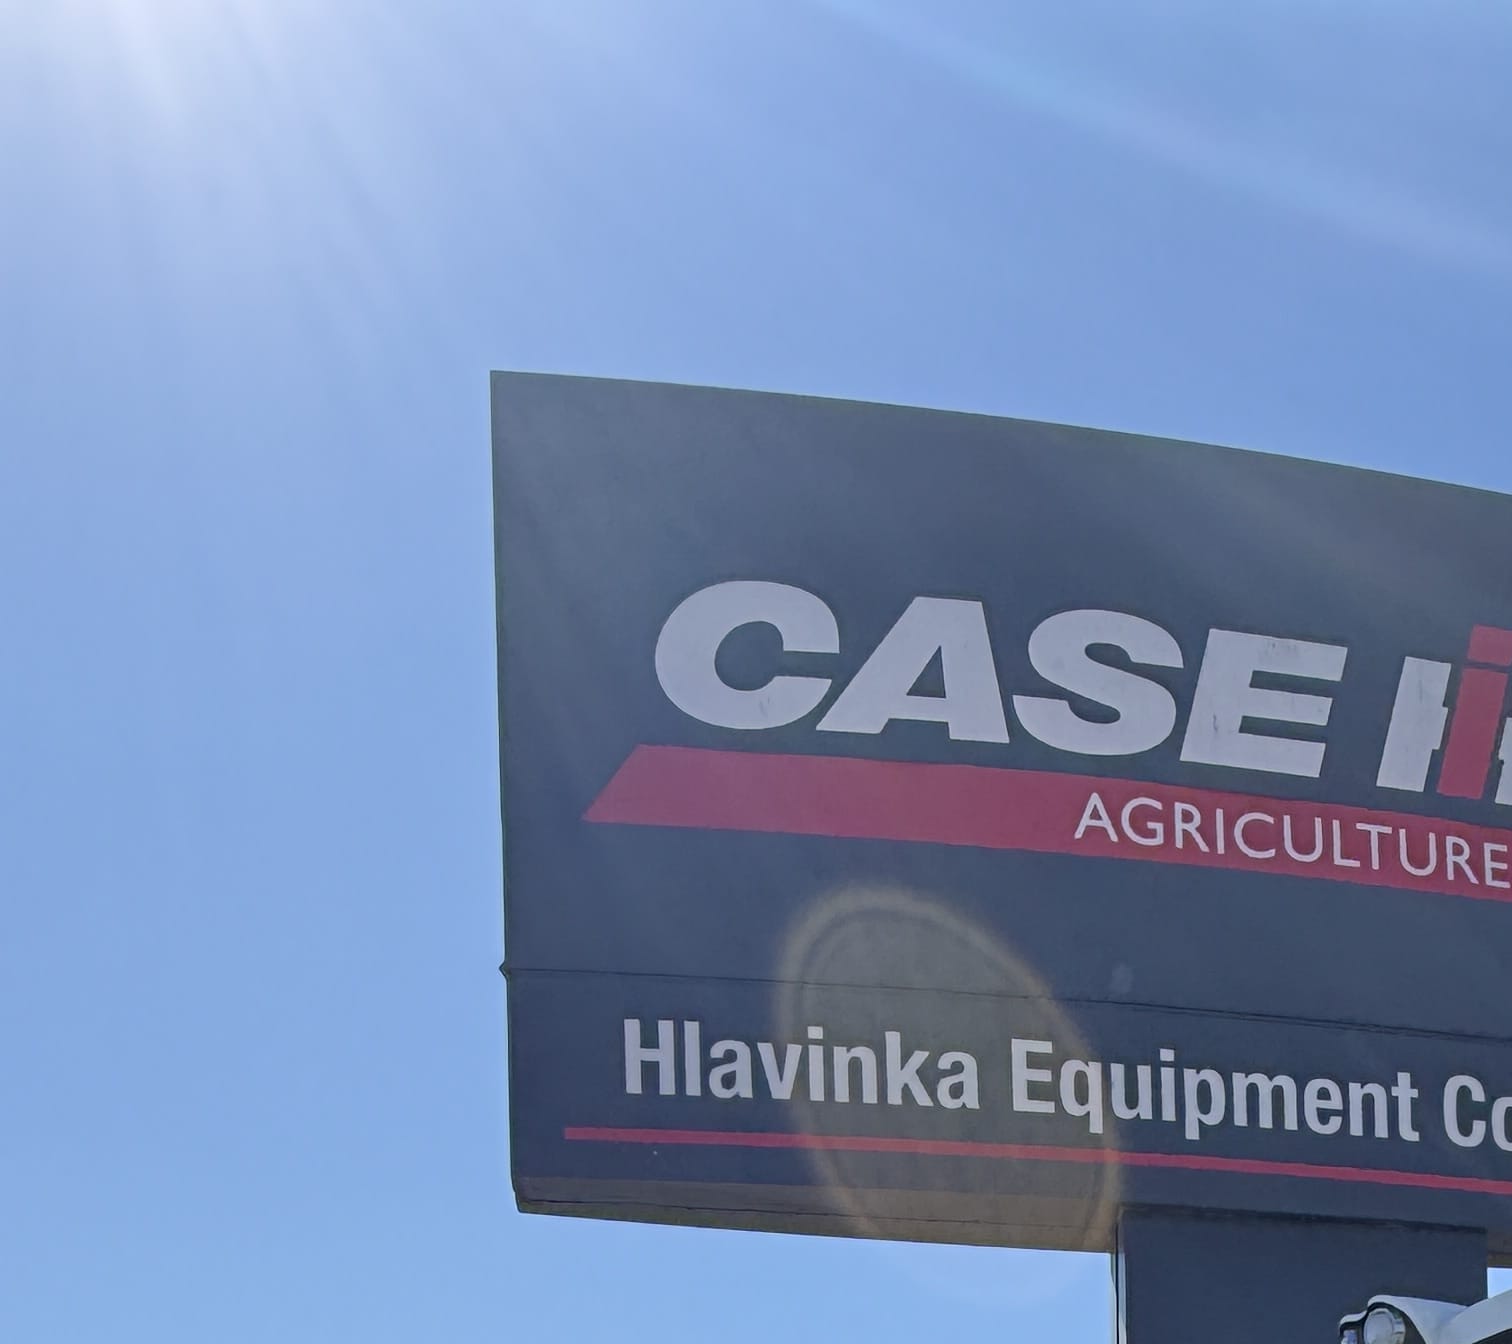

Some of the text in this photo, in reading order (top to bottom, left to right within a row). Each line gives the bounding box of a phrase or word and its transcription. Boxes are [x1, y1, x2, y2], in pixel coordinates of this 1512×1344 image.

[655, 580, 1347, 778] CASE
[1074, 792, 1511, 889] AGRICULTURE
[624, 1019, 980, 1110] Hlavinka
[1011, 1038, 1419, 1142] Equipment
